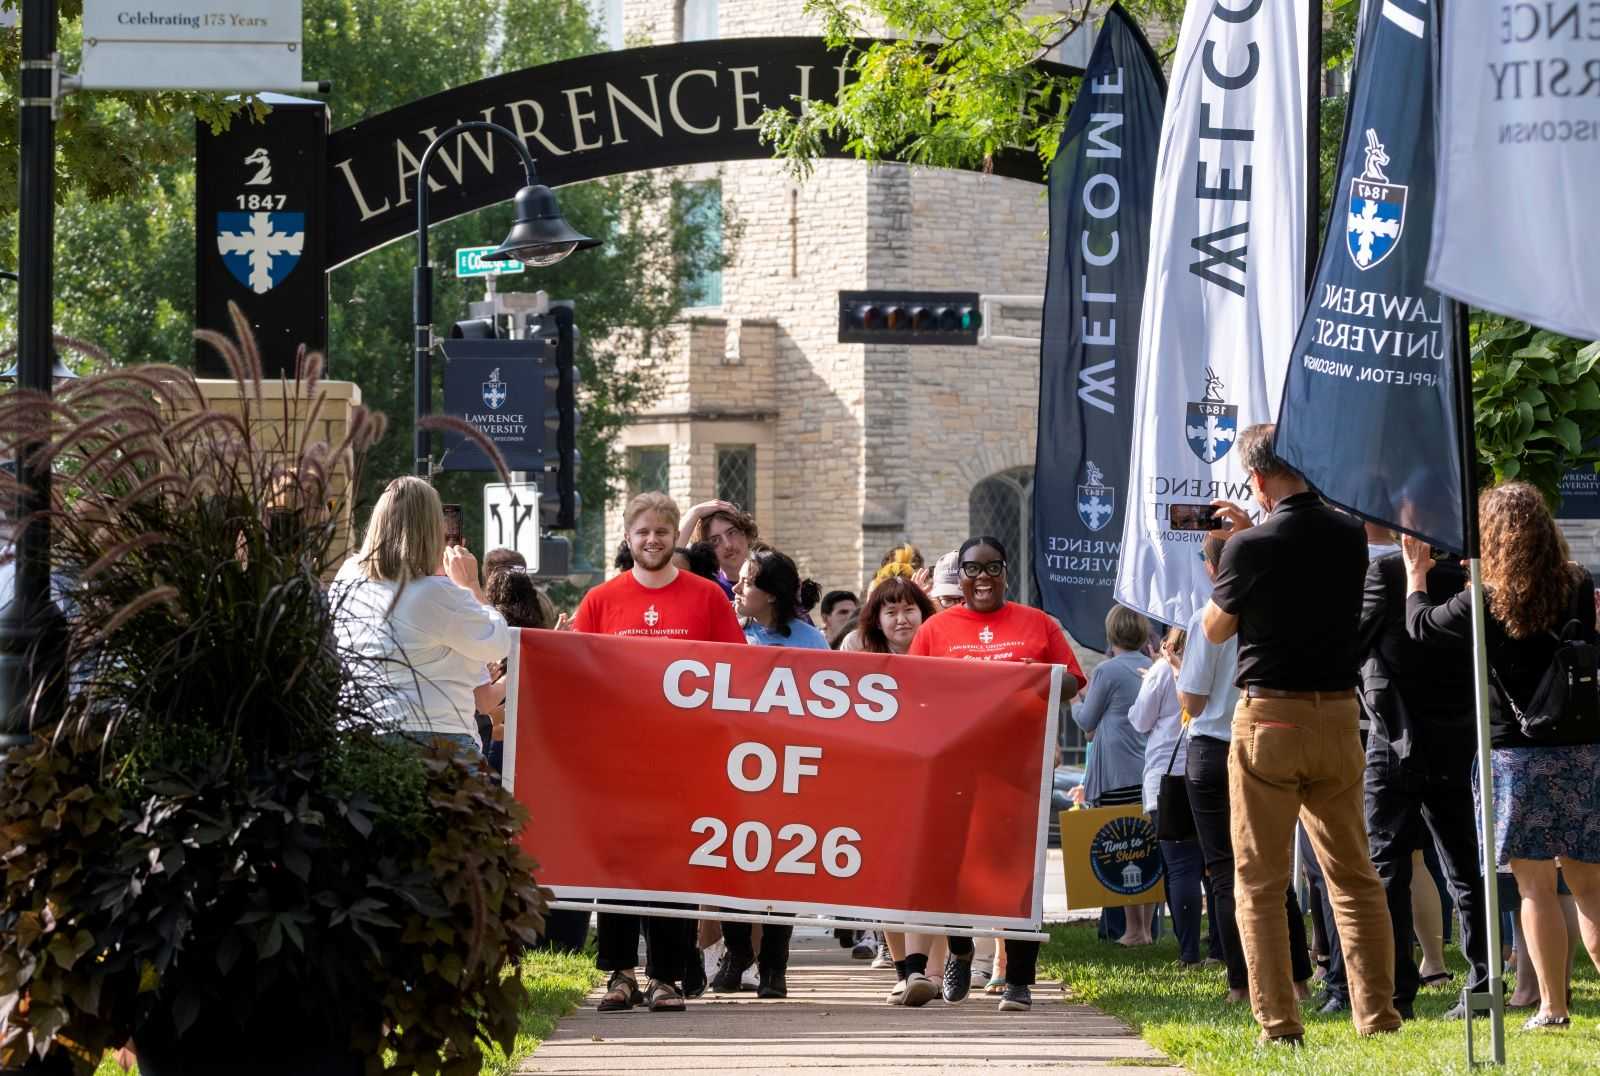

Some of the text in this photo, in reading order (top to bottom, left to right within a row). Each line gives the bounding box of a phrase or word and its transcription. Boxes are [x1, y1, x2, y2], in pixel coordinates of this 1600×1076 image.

[117, 11, 270, 29] Celebrating 175 Years
[334, 66, 764, 222] LAWRENCE
[236, 195, 287, 210] 1847
[464, 413, 525, 423] LAWRENCE
[662, 658, 900, 723] CLASS
[726, 741, 823, 795] OF
[688, 816, 863, 878] 2026
[1102, 838, 1143, 853] Time to
[1115, 844, 1150, 863] Shine!
